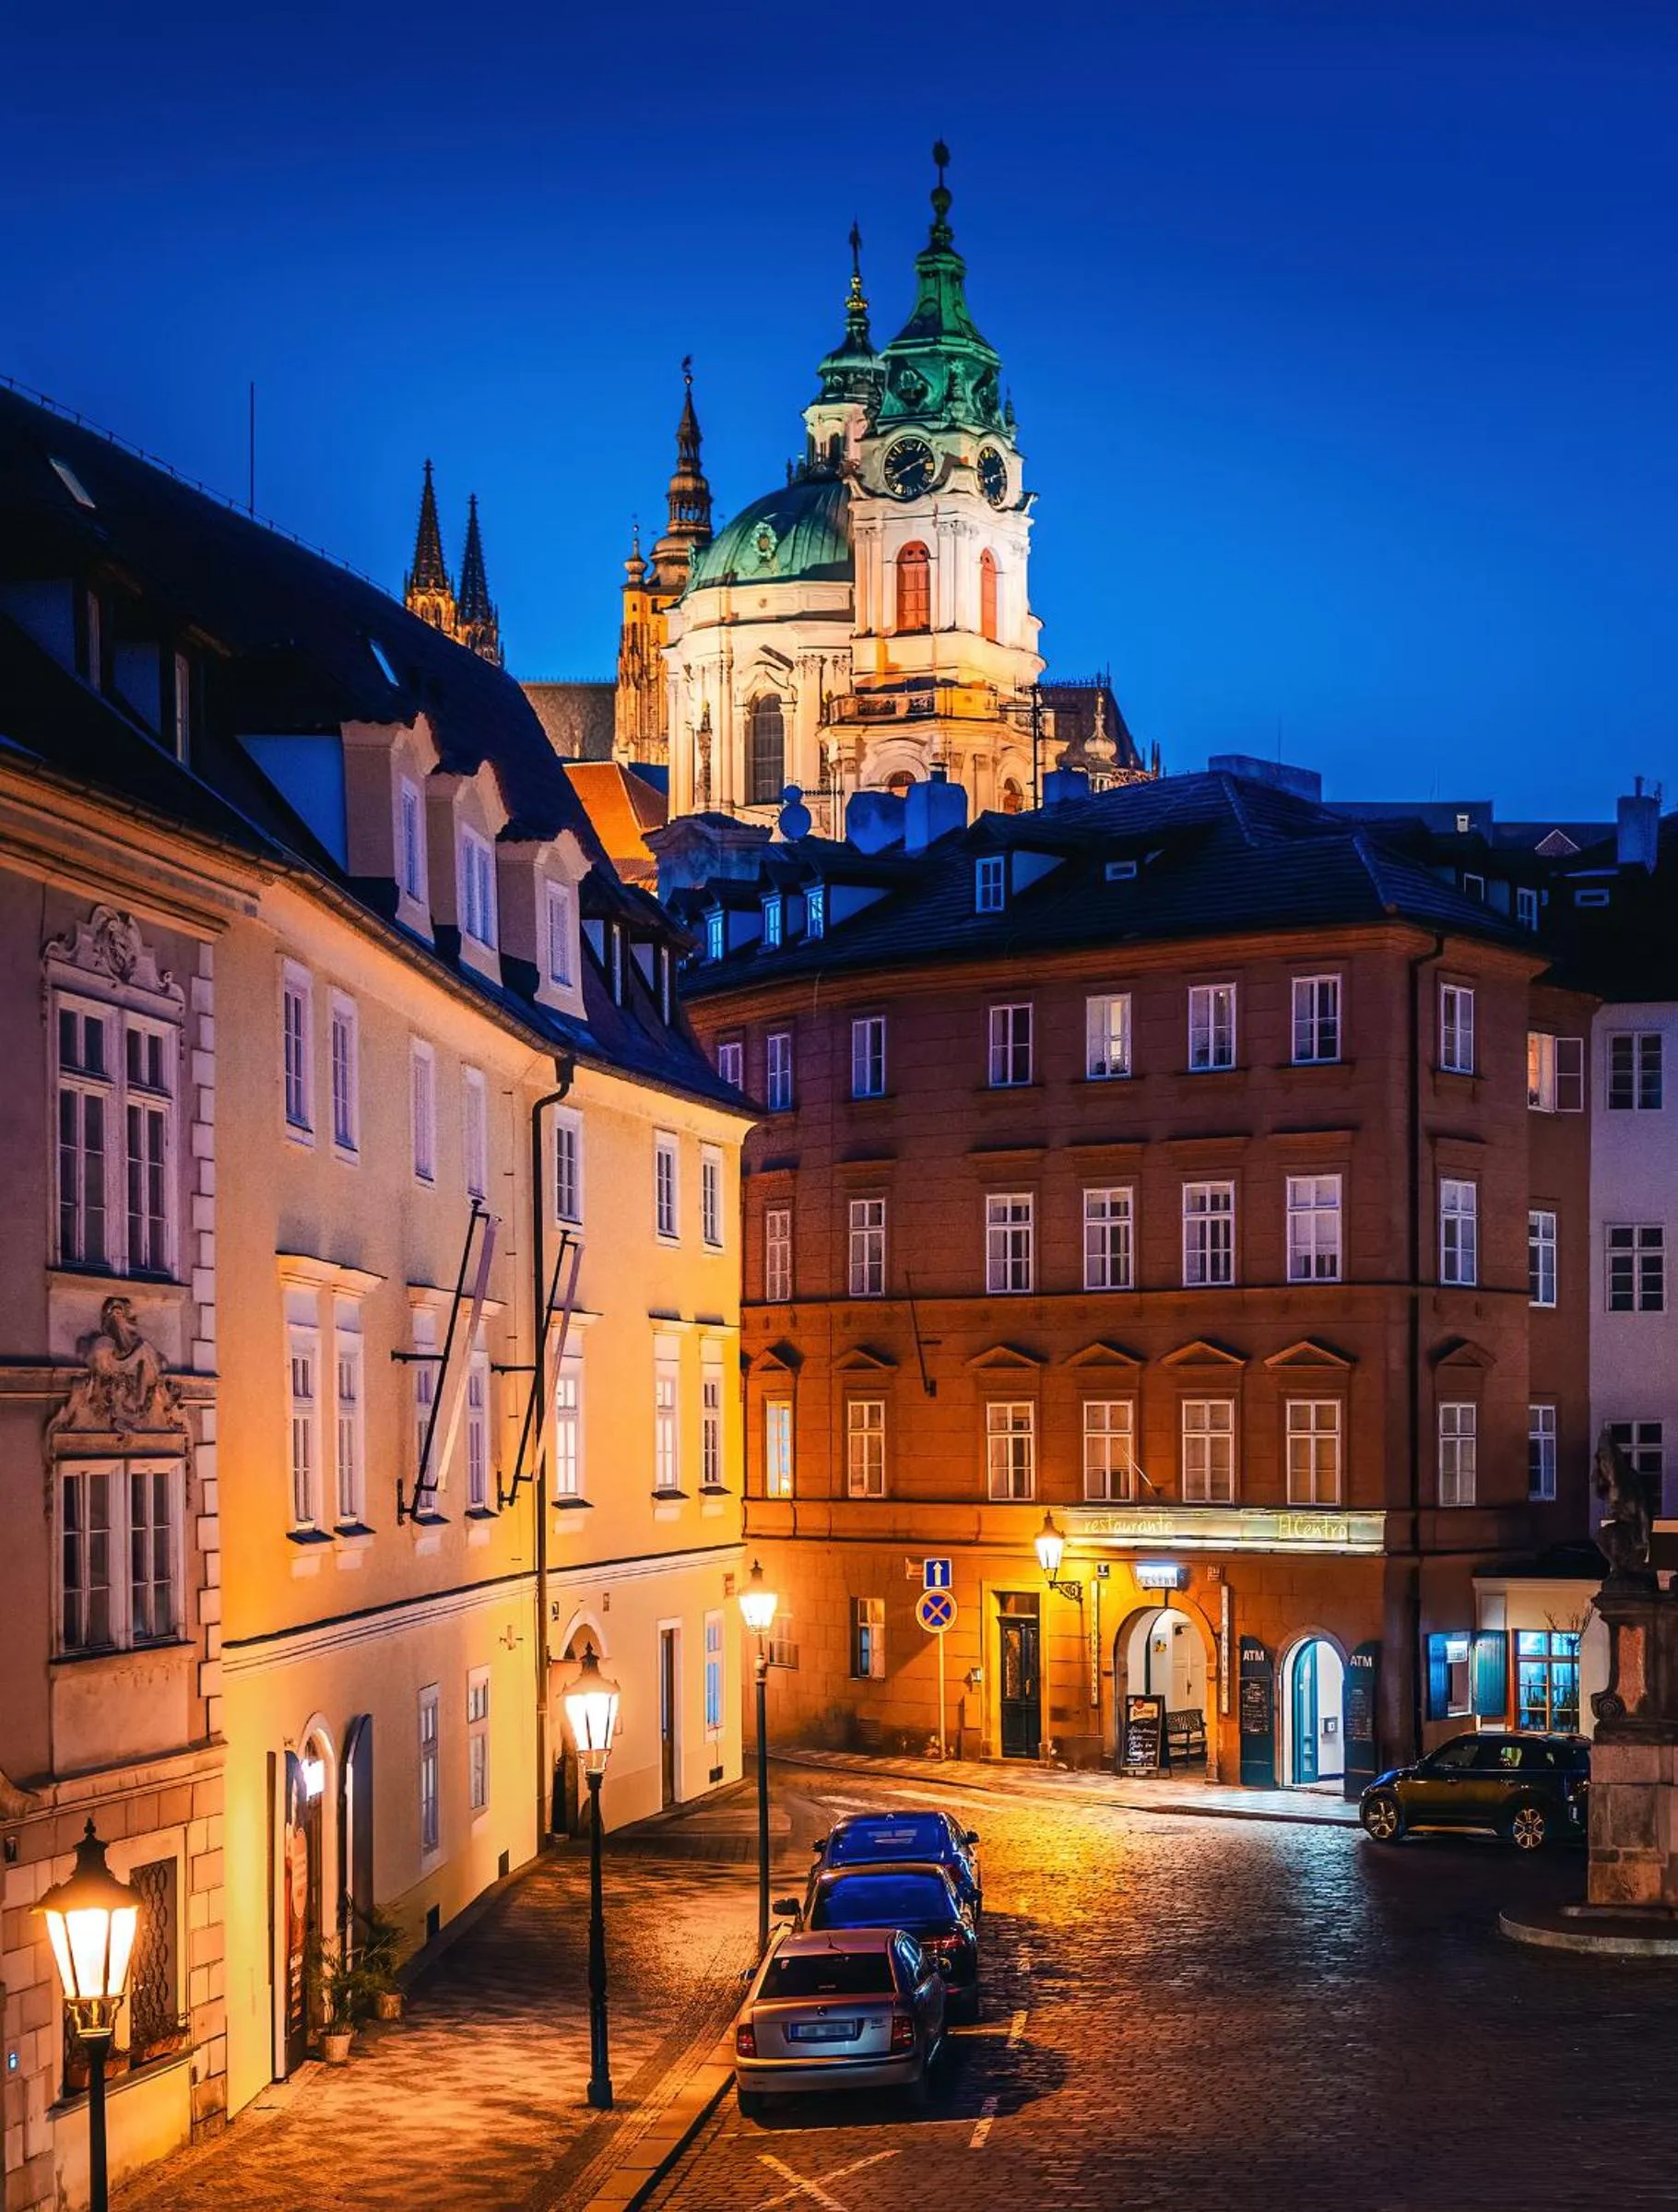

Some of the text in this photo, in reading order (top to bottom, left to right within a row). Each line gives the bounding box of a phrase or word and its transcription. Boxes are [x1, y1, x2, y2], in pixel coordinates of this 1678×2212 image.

[1082, 1513, 1176, 1533] restaurante
[1243, 1650, 1265, 1662] ATM
[1350, 1655, 1373, 1667] ATM
